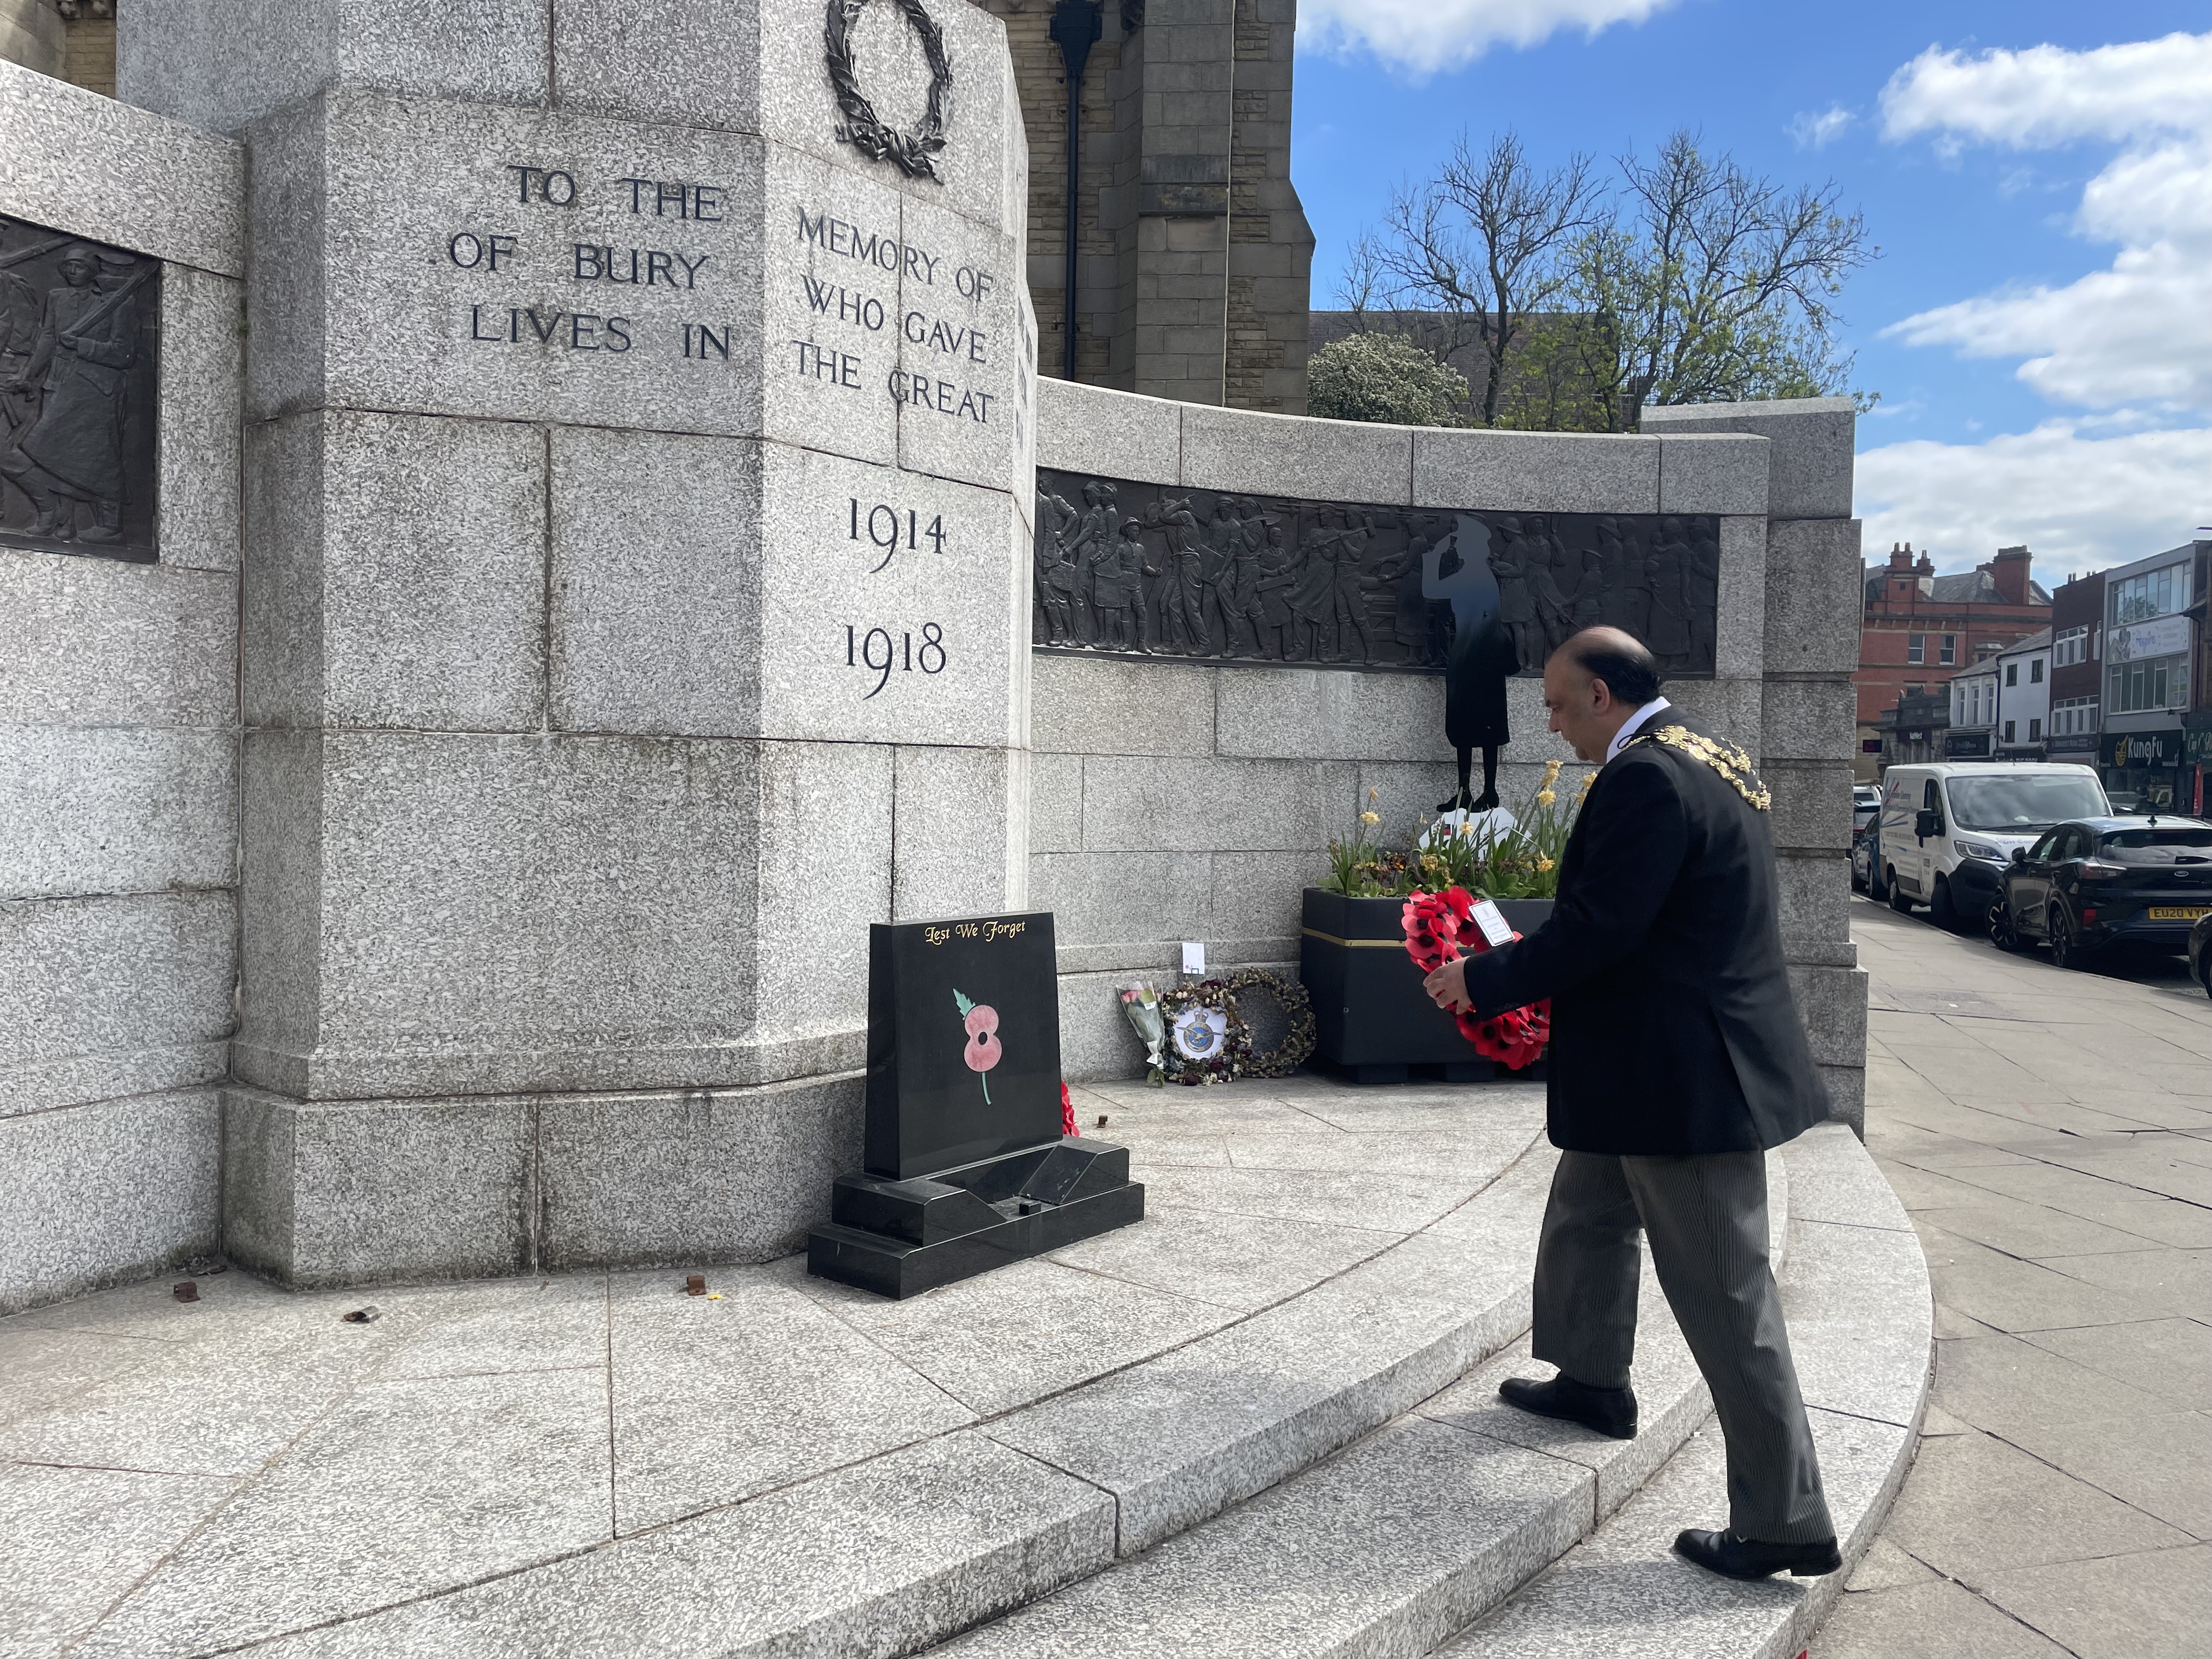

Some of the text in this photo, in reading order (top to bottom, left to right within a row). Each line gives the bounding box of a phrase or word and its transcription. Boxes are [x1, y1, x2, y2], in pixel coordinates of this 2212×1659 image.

[507, 165, 723, 221] TO THE
[450, 232, 710, 289] OF BURY
[797, 205, 994, 302] MEMORY OF
[470, 304, 730, 360] LIVES IN
[800, 274, 884, 330] WHO
[905, 311, 987, 364] GAVE
[791, 338, 861, 390] THE
[888, 368, 994, 424] GREAT
[849, 497, 947, 574] 1914
[845, 622, 946, 701] 1918
[924, 920, 1026, 945] Lest We Forget
[2154, 908, 2183, 918] EU20
